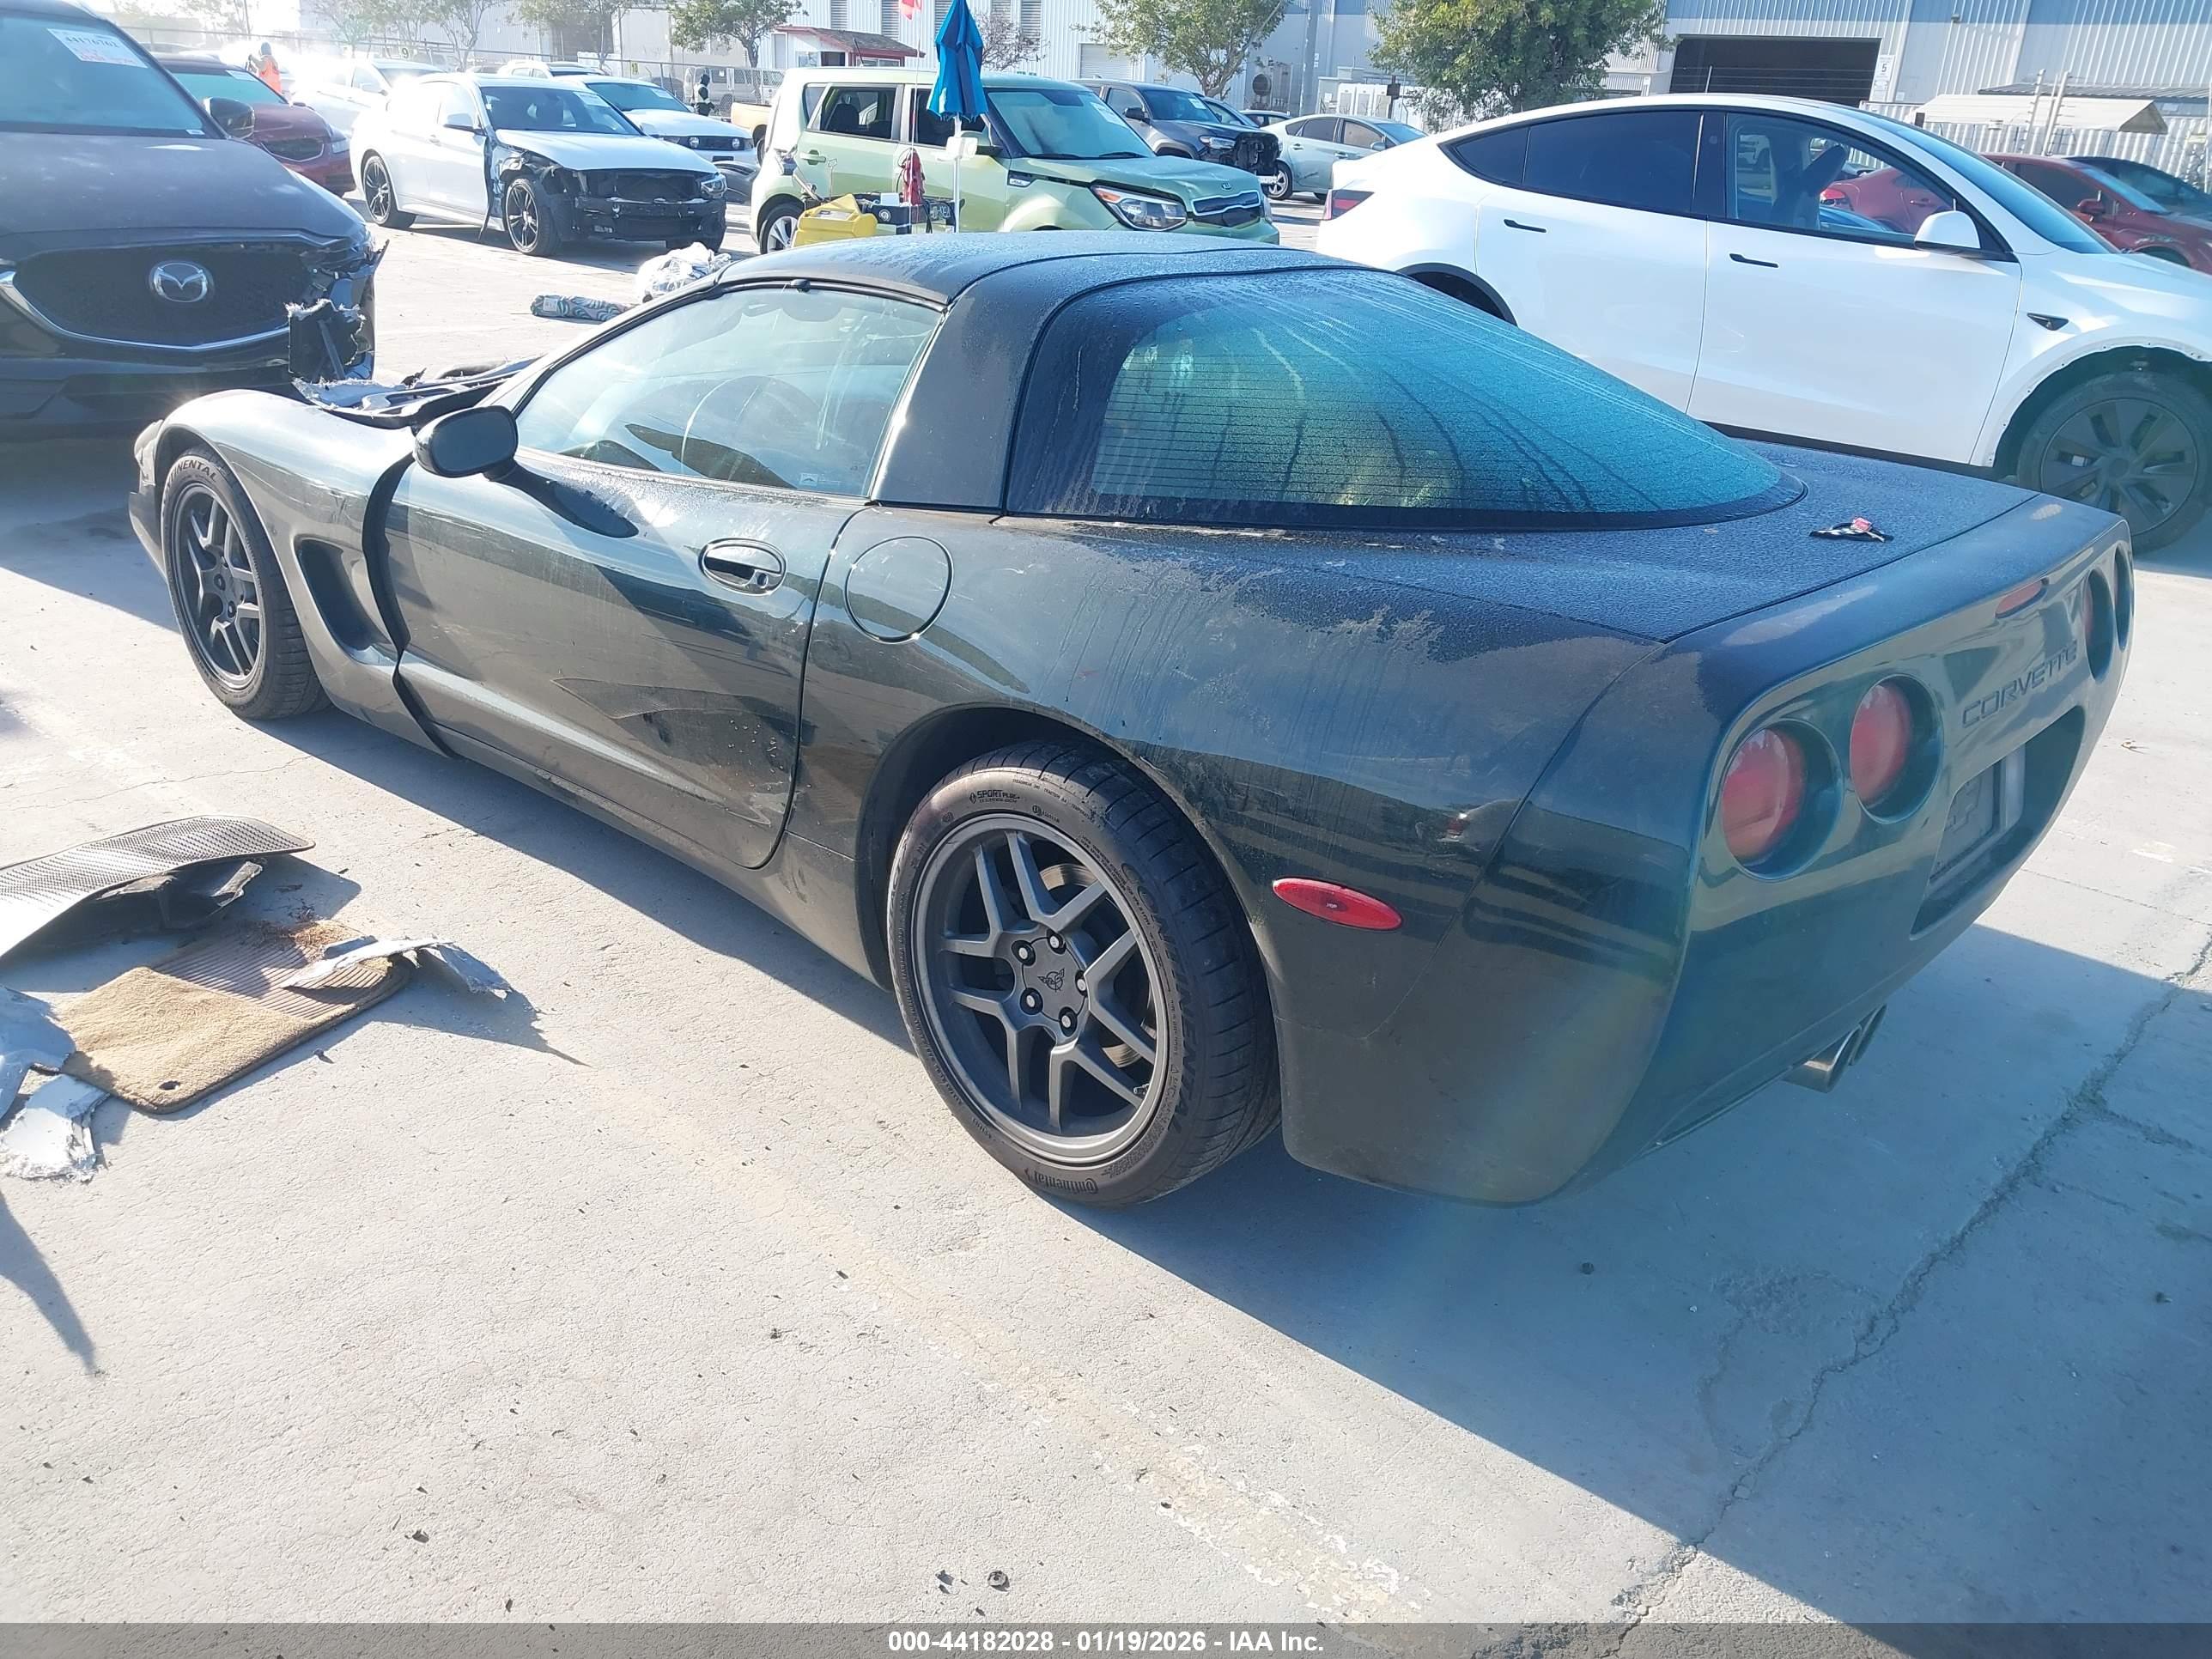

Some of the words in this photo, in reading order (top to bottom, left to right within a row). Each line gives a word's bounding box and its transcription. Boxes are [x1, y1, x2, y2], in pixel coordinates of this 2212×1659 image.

[401, 47, 409, 59] 9
[1963, 641, 2077, 727] CORVETTE
[1121, 862, 1197, 1133] CONTINENTAL
[1034, 1170, 1099, 1194] Continental
